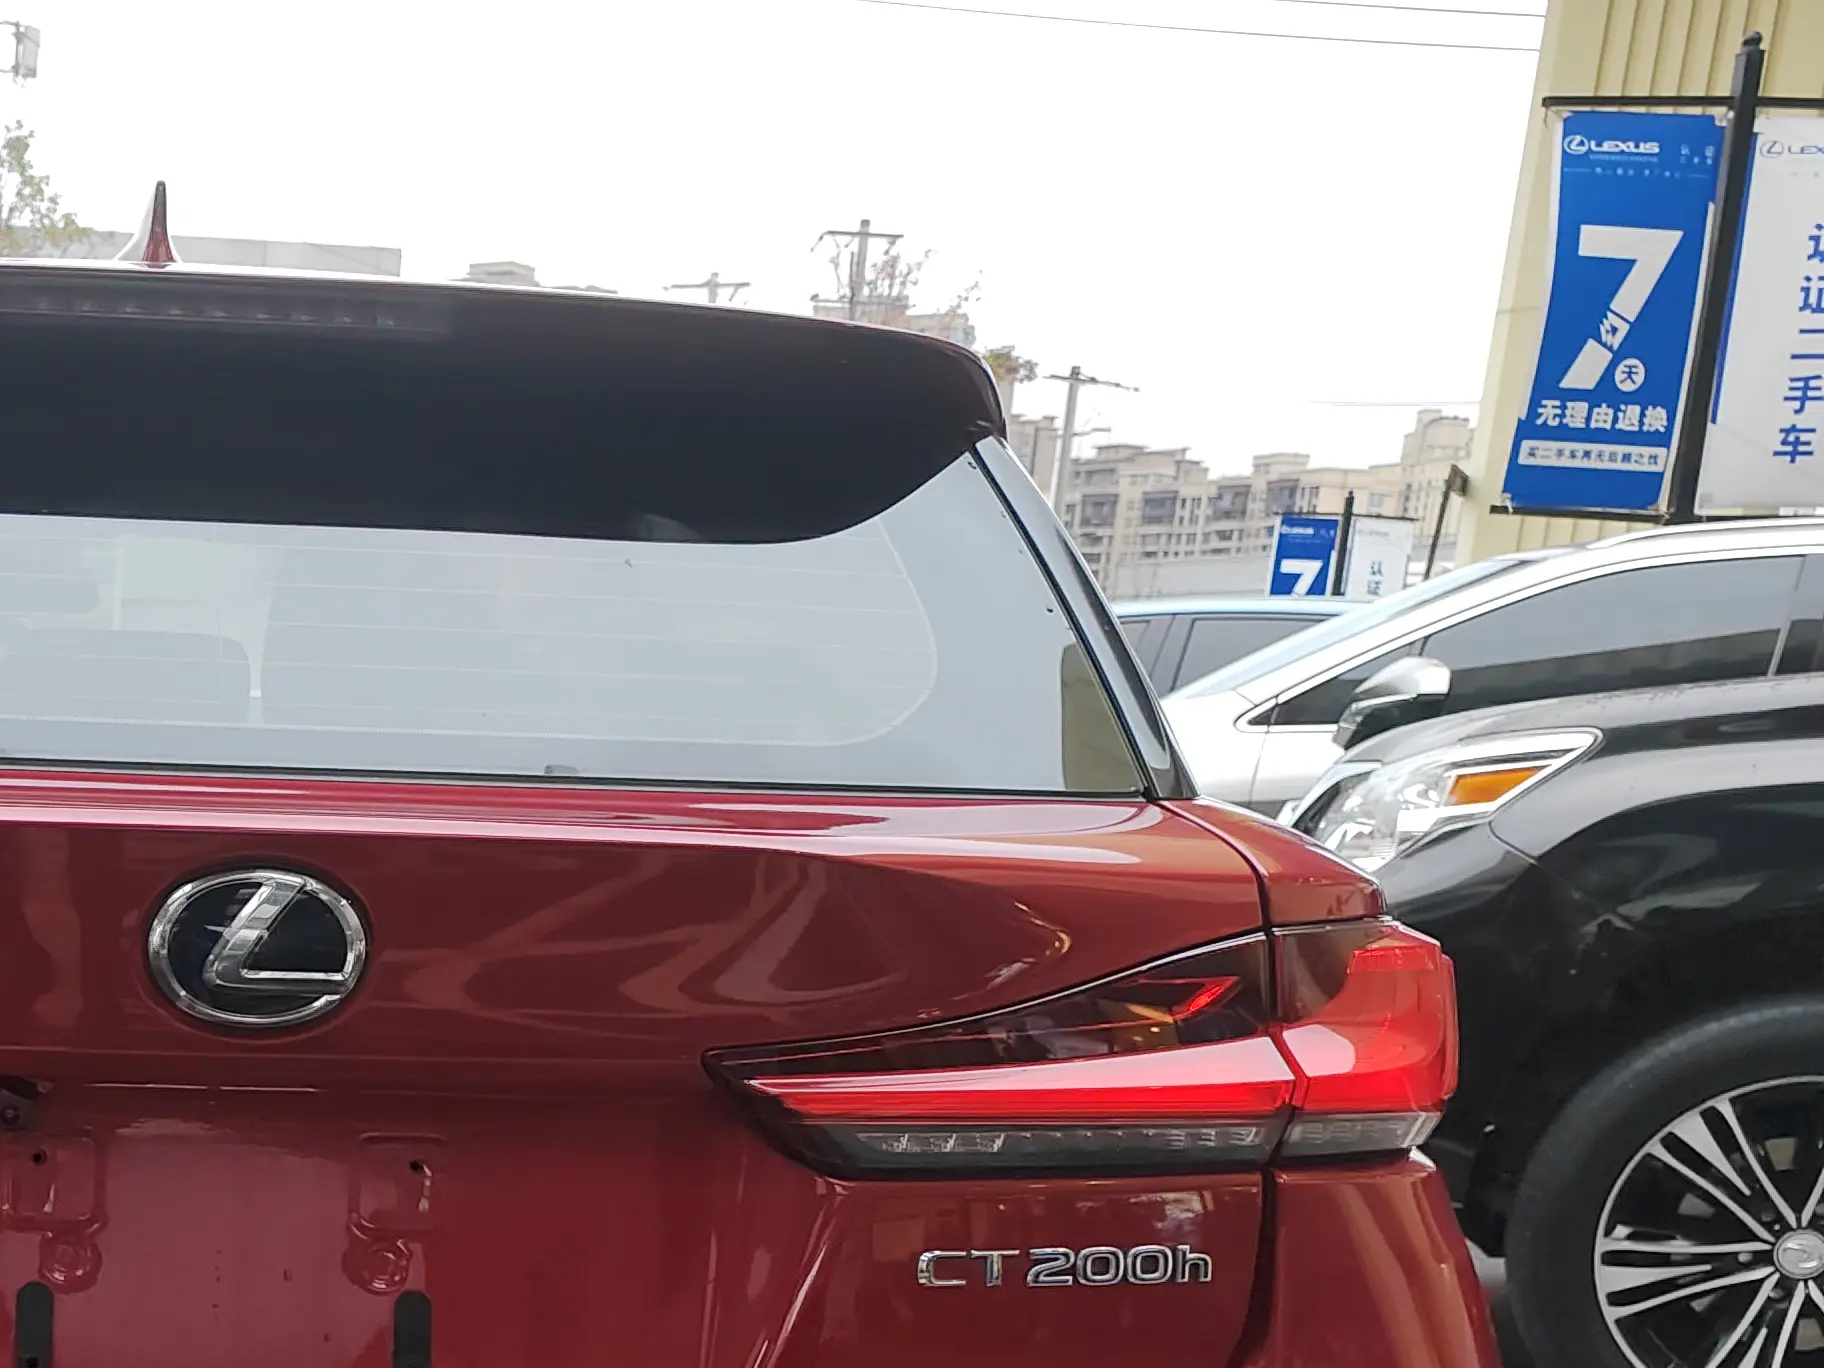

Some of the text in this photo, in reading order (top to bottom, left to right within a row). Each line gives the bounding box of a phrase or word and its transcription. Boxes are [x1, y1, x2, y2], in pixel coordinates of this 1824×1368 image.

[1590, 140, 1660, 153] LEXUS
[1558, 223, 1684, 390] 7
[1619, 364, 1640, 385] 天
[1534, 399, 1669, 433] 无理由退换
[916, 1244, 1213, 1287] CT 200h
